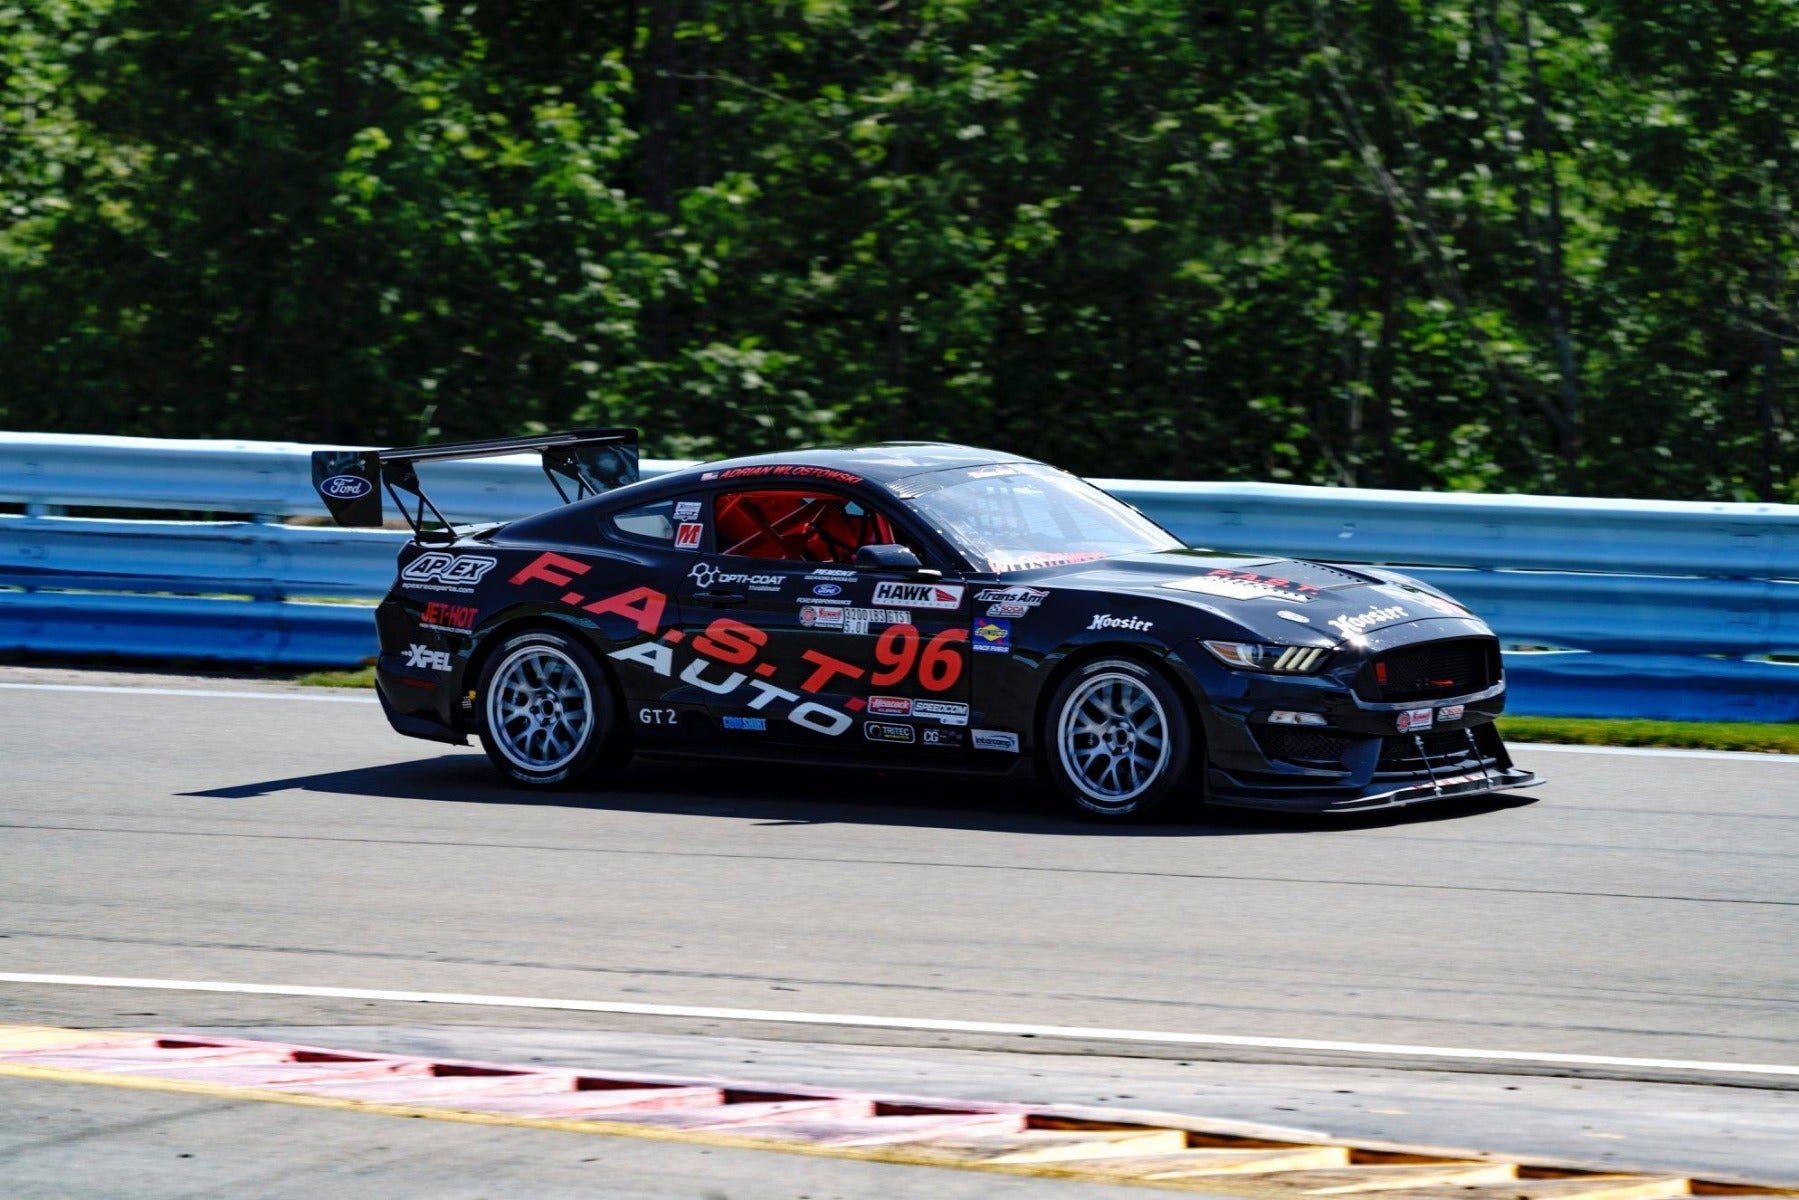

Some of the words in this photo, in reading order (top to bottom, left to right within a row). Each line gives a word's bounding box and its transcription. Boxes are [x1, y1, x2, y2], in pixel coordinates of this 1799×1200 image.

[719, 466, 773, 480] ADRIAN
[772, 465, 863, 485] WLOSTOWSKI
[330, 478, 362, 494] Ford
[410, 558, 487, 578] APEX
[719, 574, 786, 585] OPTI-COAT
[877, 584, 933, 601] HAWK
[980, 590, 1017, 602] Trans
[1017, 592, 1042, 603] Am
[420, 601, 478, 628] JET-HOT
[1086, 614, 1153, 631] Hoosier
[1328, 604, 1409, 642] Hoosier
[406, 643, 452, 672] XPEL
[871, 623, 969, 692] 96
[606, 640, 853, 737] AUTO
[915, 702, 968, 714] SPEEDCOM
[882, 726, 910, 736] TRITEC
